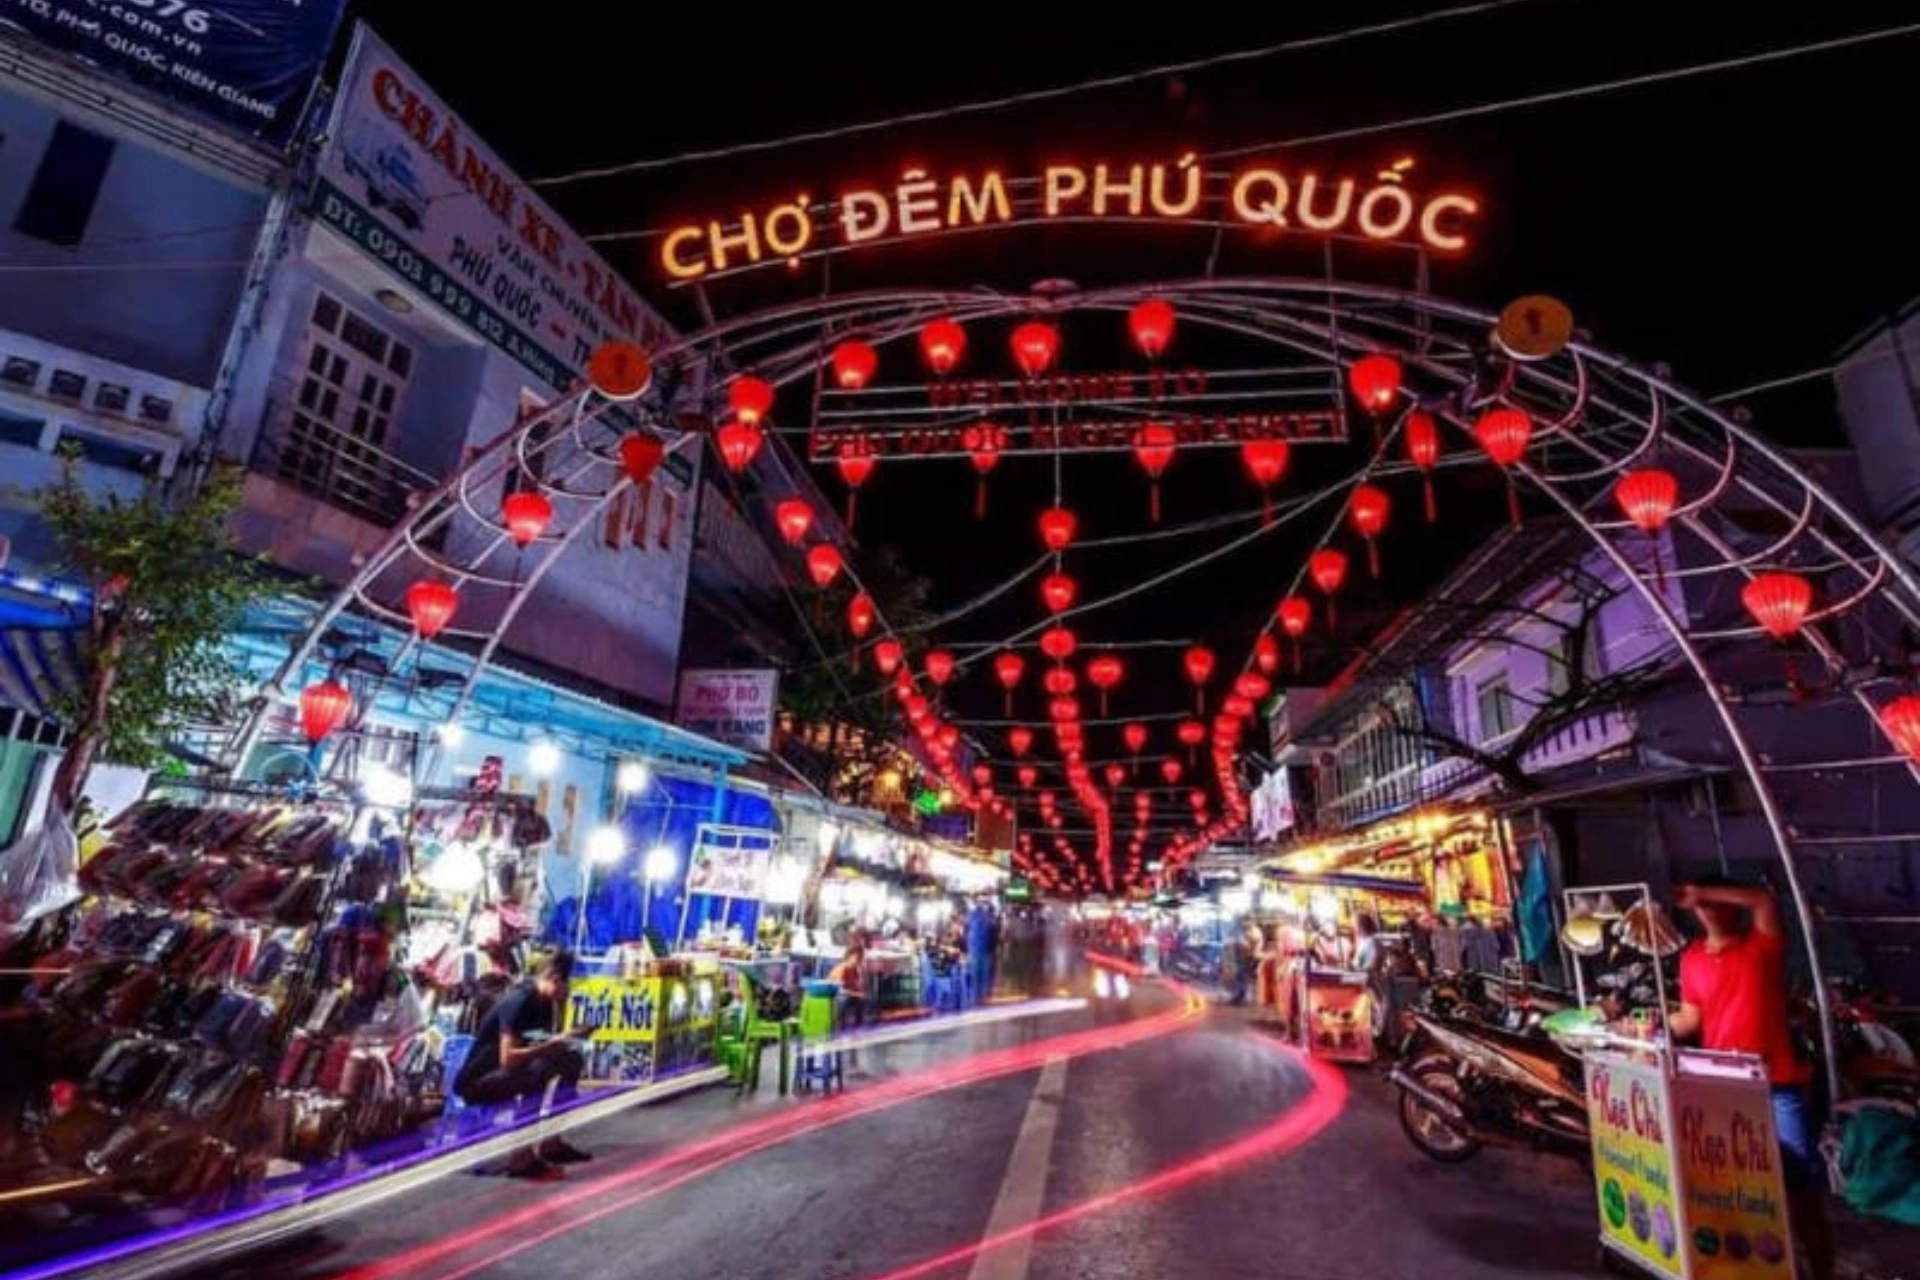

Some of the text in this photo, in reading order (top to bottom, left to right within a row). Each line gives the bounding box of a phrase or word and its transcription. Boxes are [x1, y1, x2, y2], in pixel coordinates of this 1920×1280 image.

[88, 0, 201, 55] .com.vn
[128, 0, 210, 34] 76
[518, 202, 566, 273] XE
[660, 151, 1479, 278] CHỢ ĐÊM PHÚ QUỐC
[452, 234, 493, 286] PHÚ
[494, 273, 542, 328] QUỐC
[928, 370, 1134, 410] WELCOME
